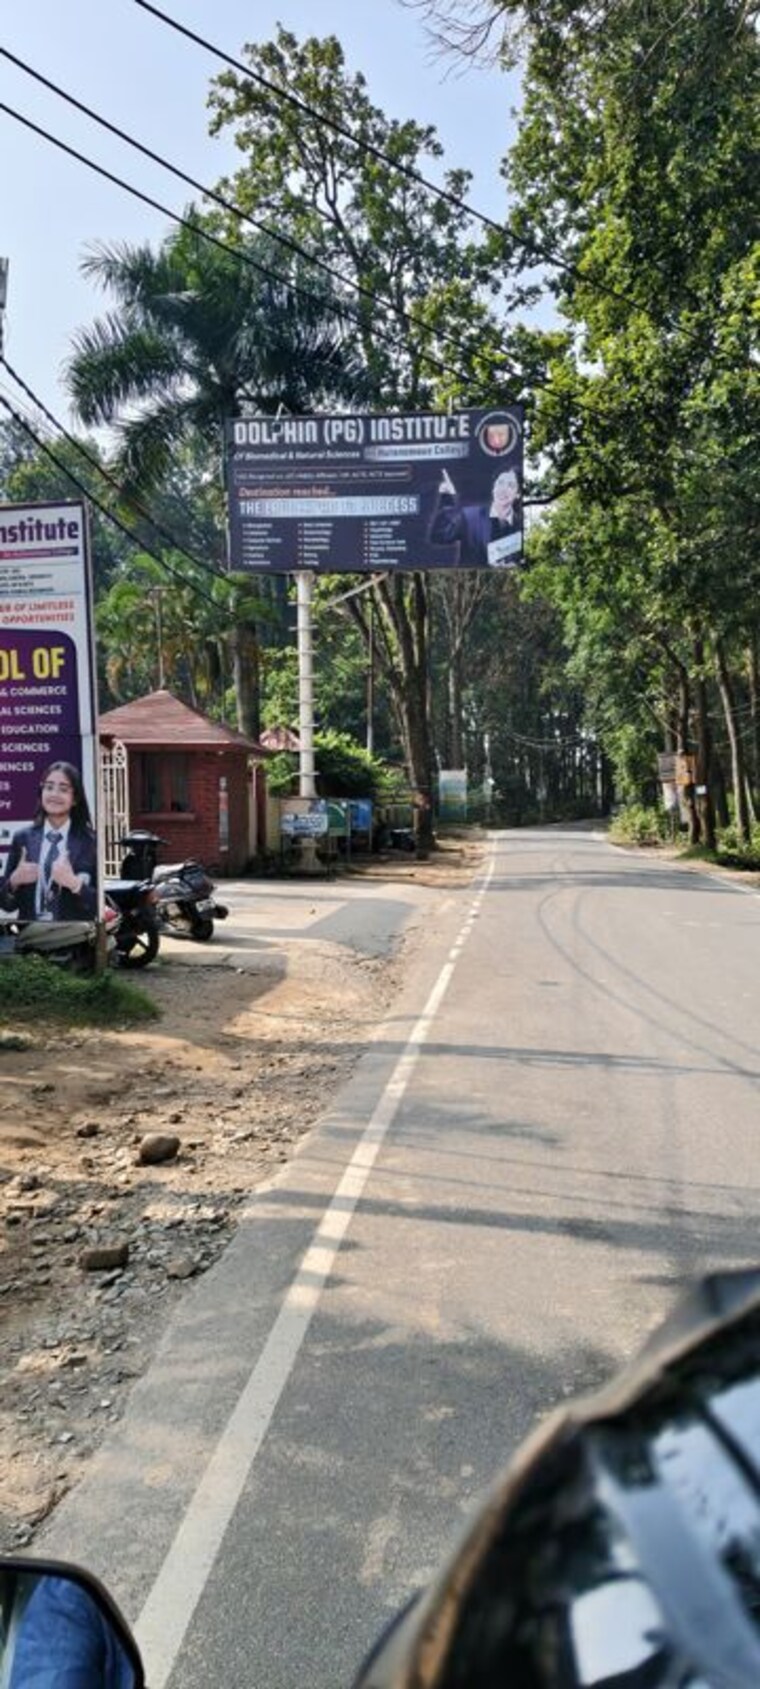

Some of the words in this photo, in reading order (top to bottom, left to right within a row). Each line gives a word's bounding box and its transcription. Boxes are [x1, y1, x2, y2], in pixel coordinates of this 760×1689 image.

[234, 420, 318, 445] DOLPHIN
[323, 419, 364, 445] (PG)
[245, 451, 287, 460] Biomedical
[295, 450, 326, 460] Natural
[326, 449, 360, 460] Sciences
[238, 487, 291, 497] Destination
[238, 501, 262, 516] THE
[2, 613, 75, 625] OPPORTUNITIES
[33, 647, 65, 679] OF
[10, 685, 67, 697] COMMERCE
[14, 705, 62, 716] SCIENCES
[1, 724, 59, 735] EDUCATION
[1, 743, 51, 753] SCIENCES
